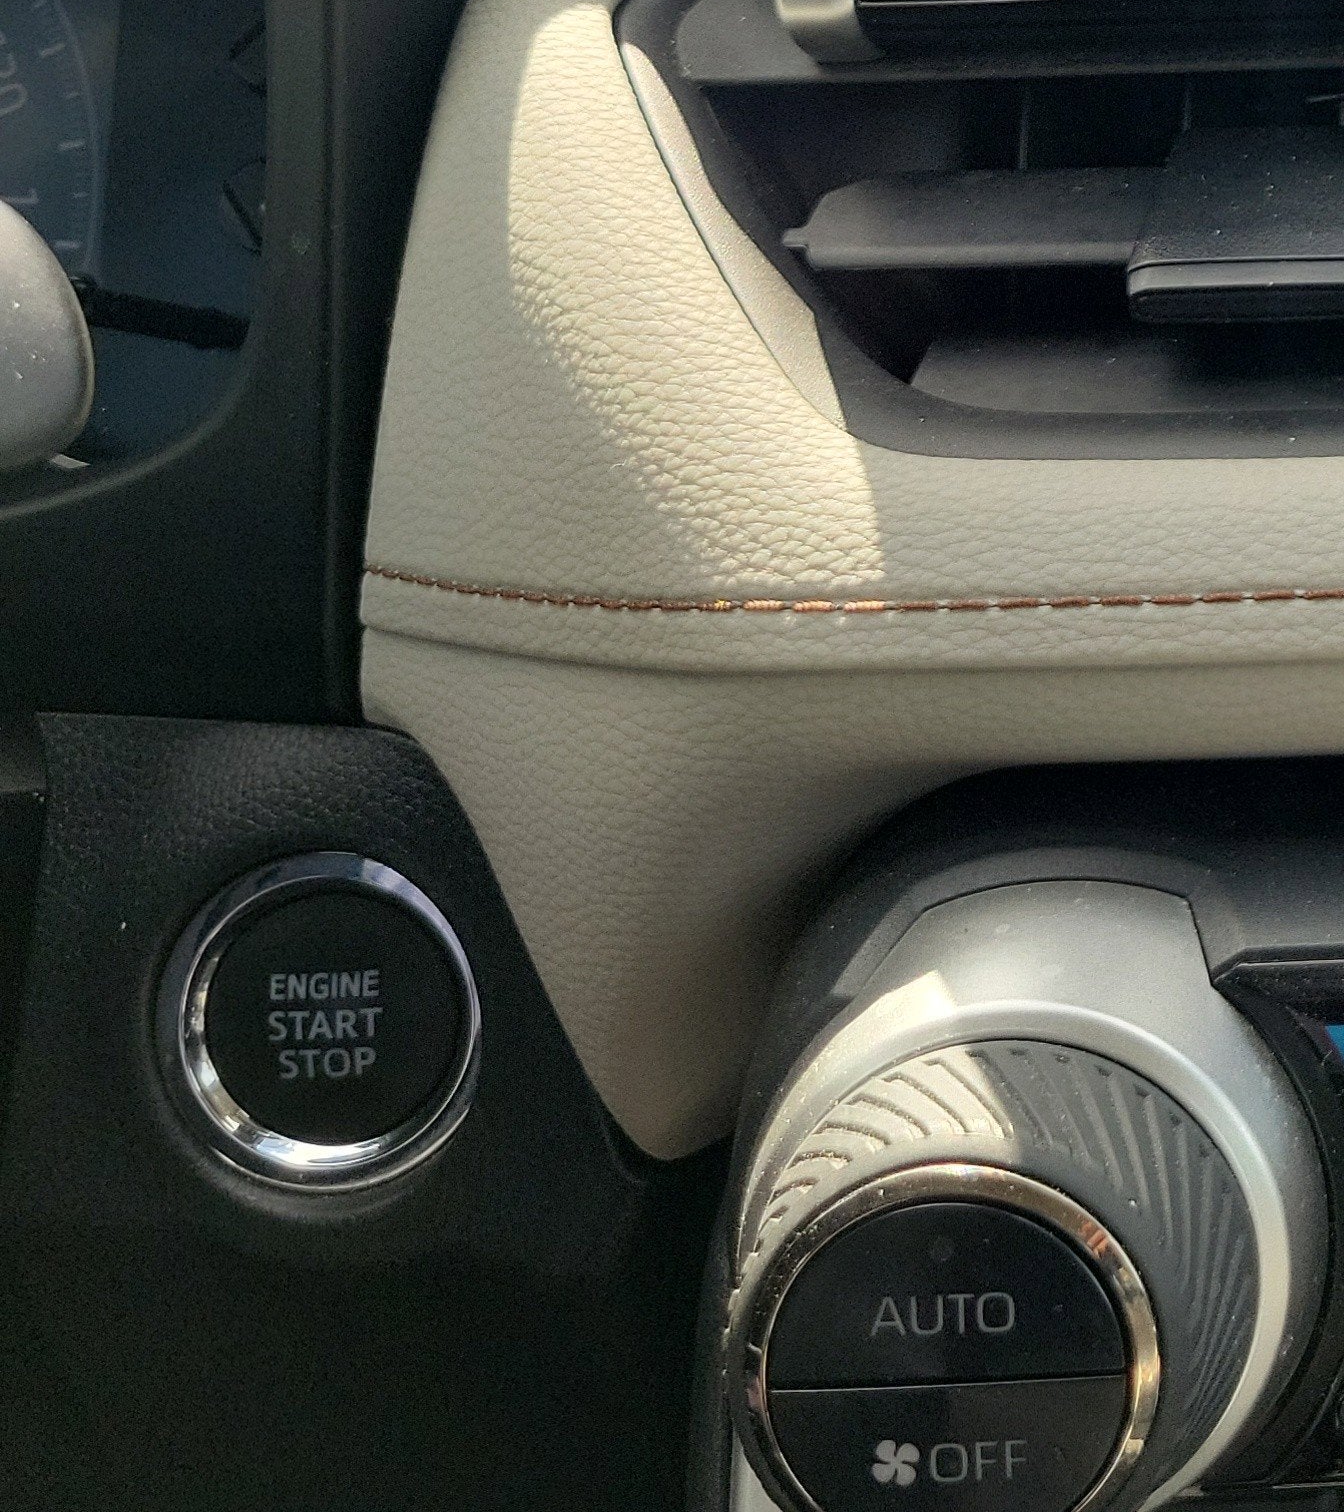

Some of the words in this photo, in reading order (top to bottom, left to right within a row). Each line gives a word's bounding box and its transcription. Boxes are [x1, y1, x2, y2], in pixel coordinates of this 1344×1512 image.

[269, 969, 381, 1001] ENGINE
[268, 1007, 384, 1041] START
[278, 1047, 377, 1080] STOP
[869, 1291, 1016, 1337] AUTO
[929, 1439, 1028, 1482] OFF
